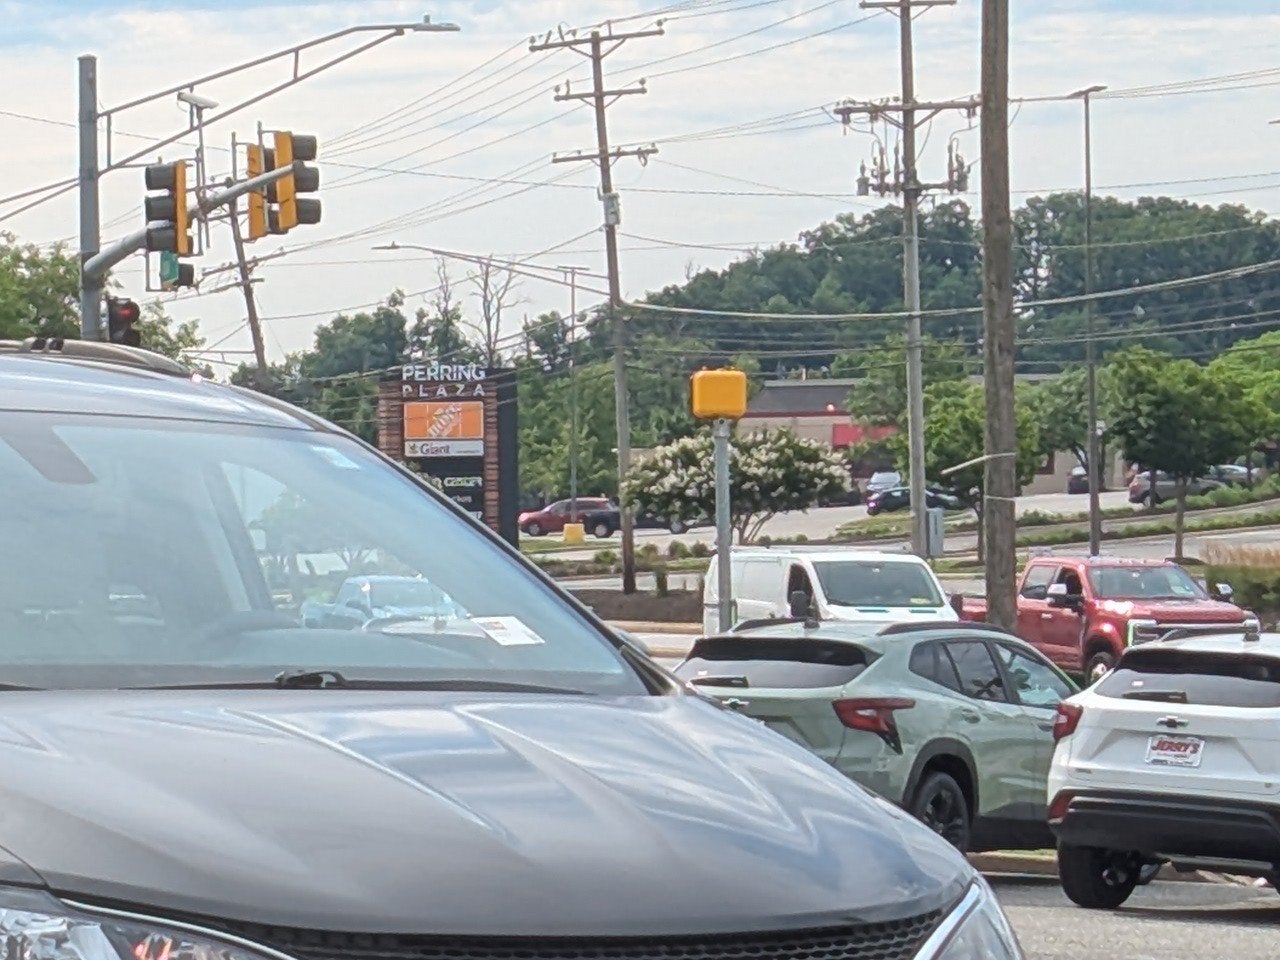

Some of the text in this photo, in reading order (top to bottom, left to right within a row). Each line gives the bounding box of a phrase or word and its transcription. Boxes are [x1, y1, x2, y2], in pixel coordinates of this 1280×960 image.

[402, 364, 486, 381] PERRING
[402, 384, 485, 397] PLAZA
[420, 442, 450, 455] Giant
